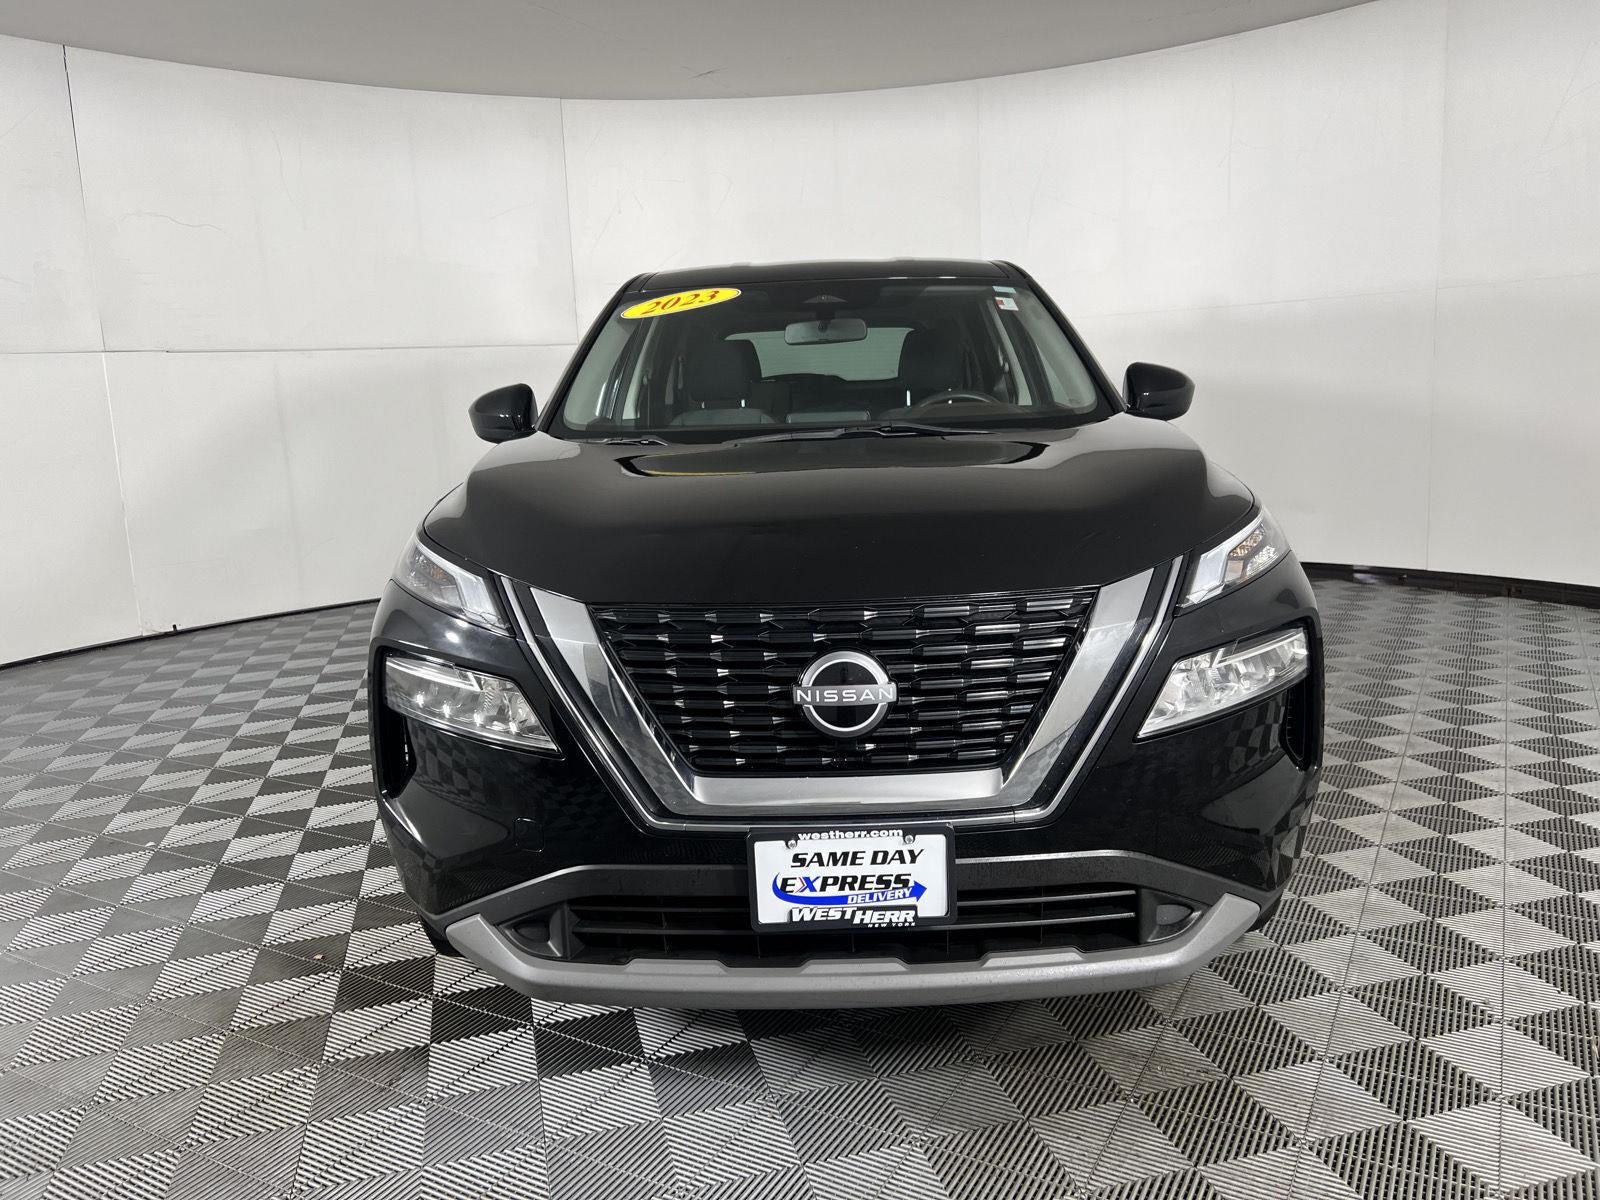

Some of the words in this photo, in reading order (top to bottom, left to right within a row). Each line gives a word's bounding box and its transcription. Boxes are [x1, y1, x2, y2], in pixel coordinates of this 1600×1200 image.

[640, 290, 720, 315] 2023
[796, 688, 894, 702] NISSAN
[798, 829, 903, 840] westherr.com
[791, 851, 866, 868] SAME
[870, 849, 925, 866] DAY
[780, 873, 912, 893] EXPRESS
[847, 888, 913, 904] DELIVERY
